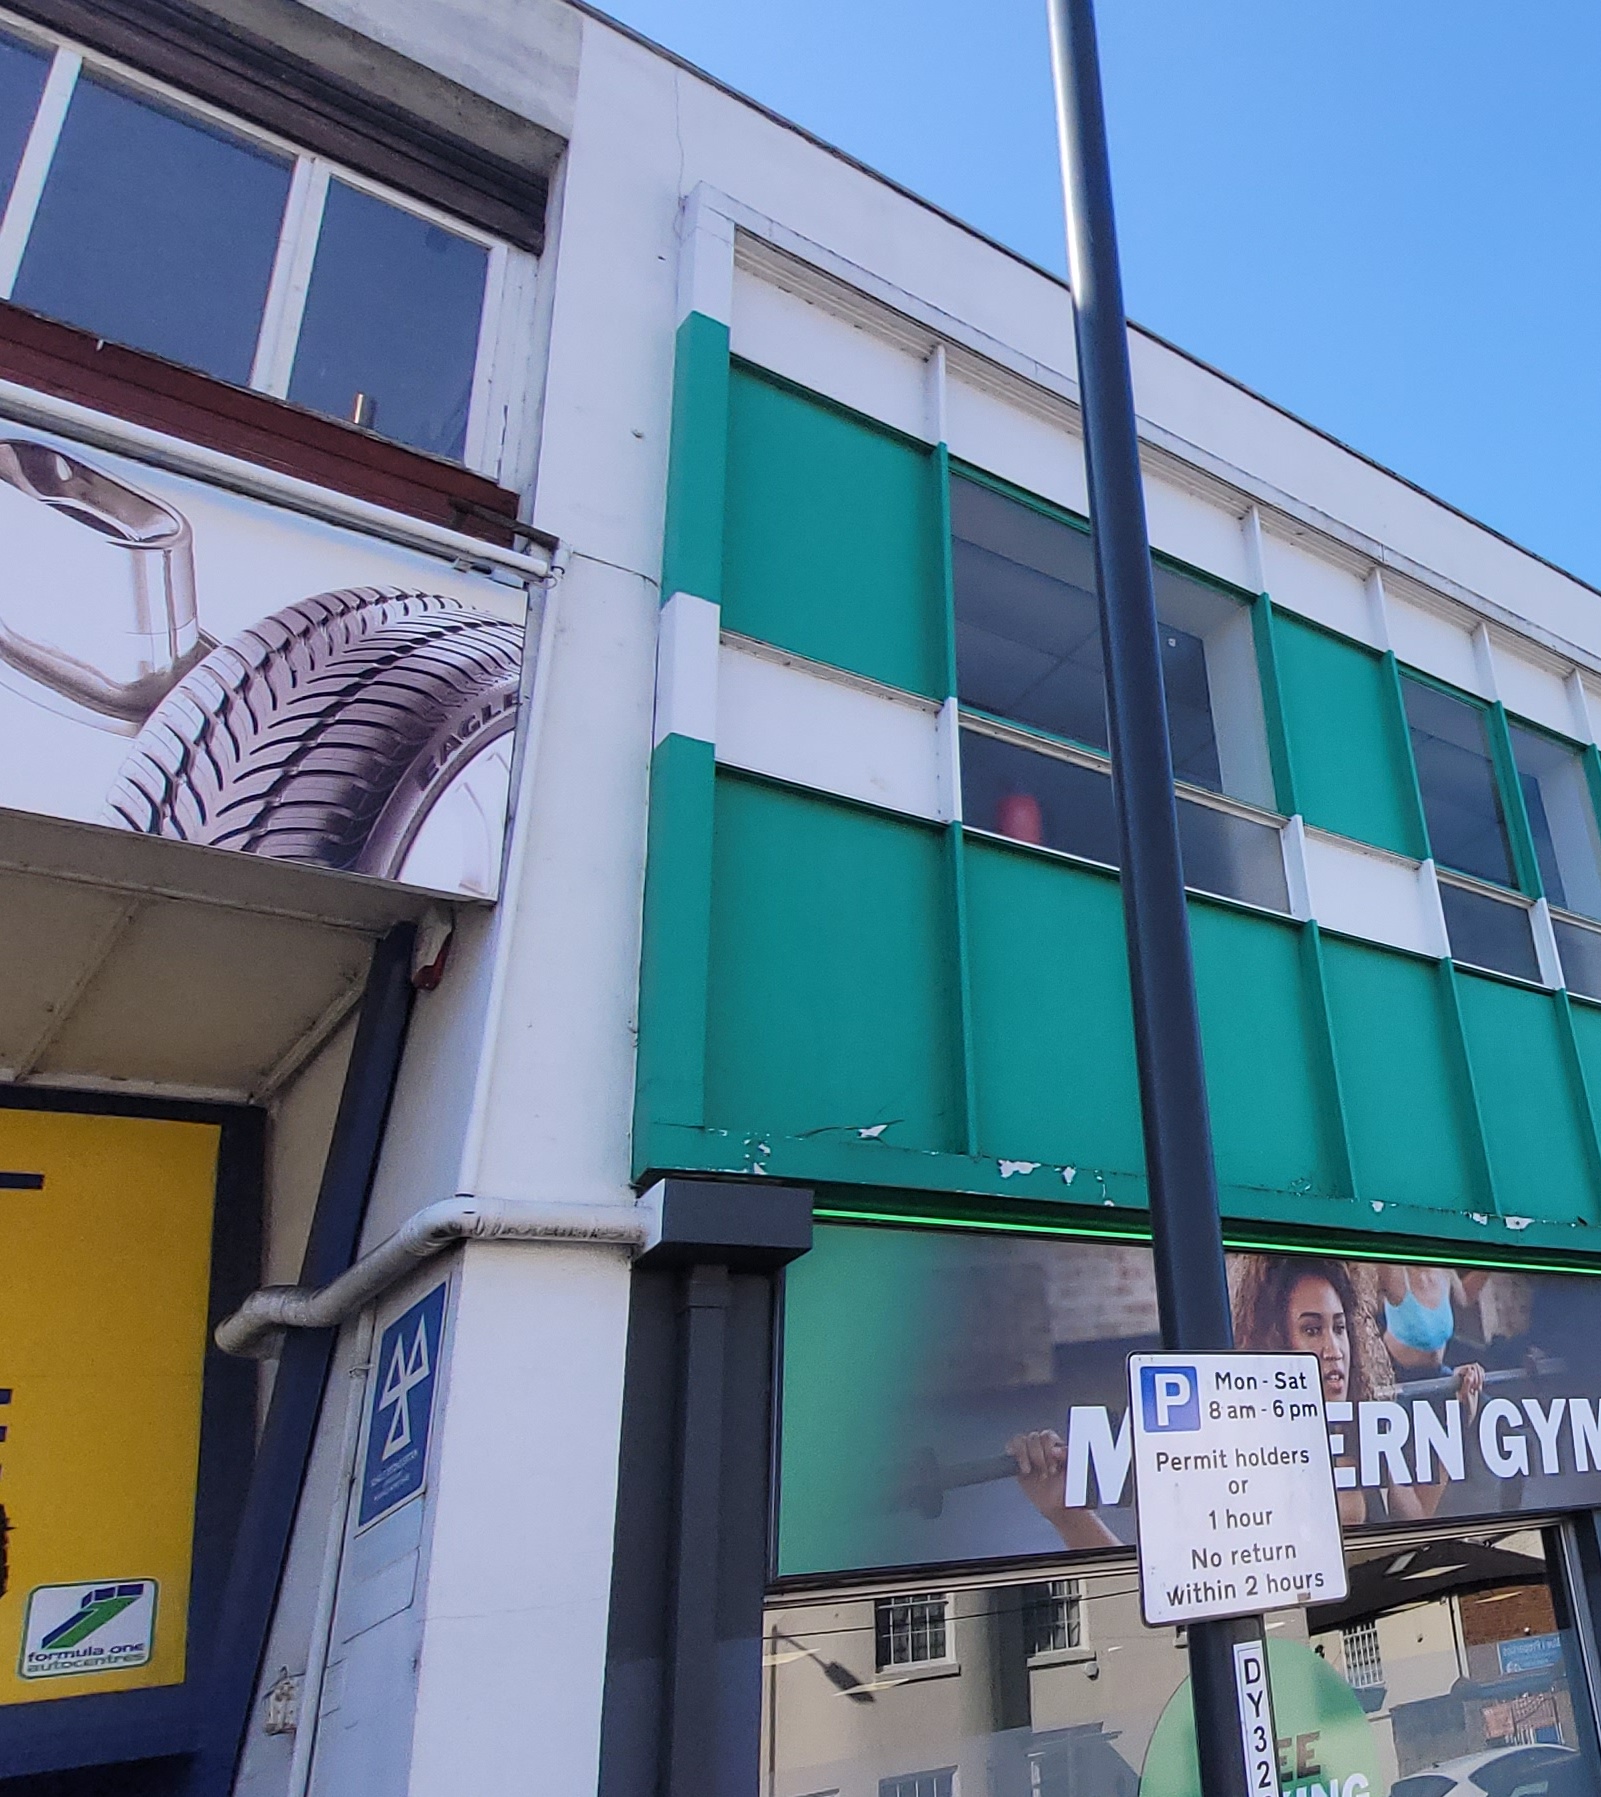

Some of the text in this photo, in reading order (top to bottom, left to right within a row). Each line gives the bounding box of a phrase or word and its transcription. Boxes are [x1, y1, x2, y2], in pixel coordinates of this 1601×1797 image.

[1215, 1372, 1257, 1390] Mon
[1274, 1371, 1308, 1390] Sat
[1154, 1373, 1192, 1427] P
[1209, 1401, 1221, 1419] 8
[1227, 1405, 1256, 1419] am
[1272, 1400, 1284, 1417] 6
[1290, 1402, 1318, 1421] pm
[1065, 1400, 1466, 1507] MERN
[1156, 1447, 1310, 1472] Permit holders
[1228, 1479, 1249, 1495] or
[1208, 1508, 1273, 1530] 1 hour
[1192, 1543, 1297, 1570] No return
[1166, 1571, 1324, 1606] within 2 hours
[27, 1652, 146, 1673] autocentres
[28, 1642, 144, 1662] formula one
[1244, 1657, 1272, 1797] DY32
